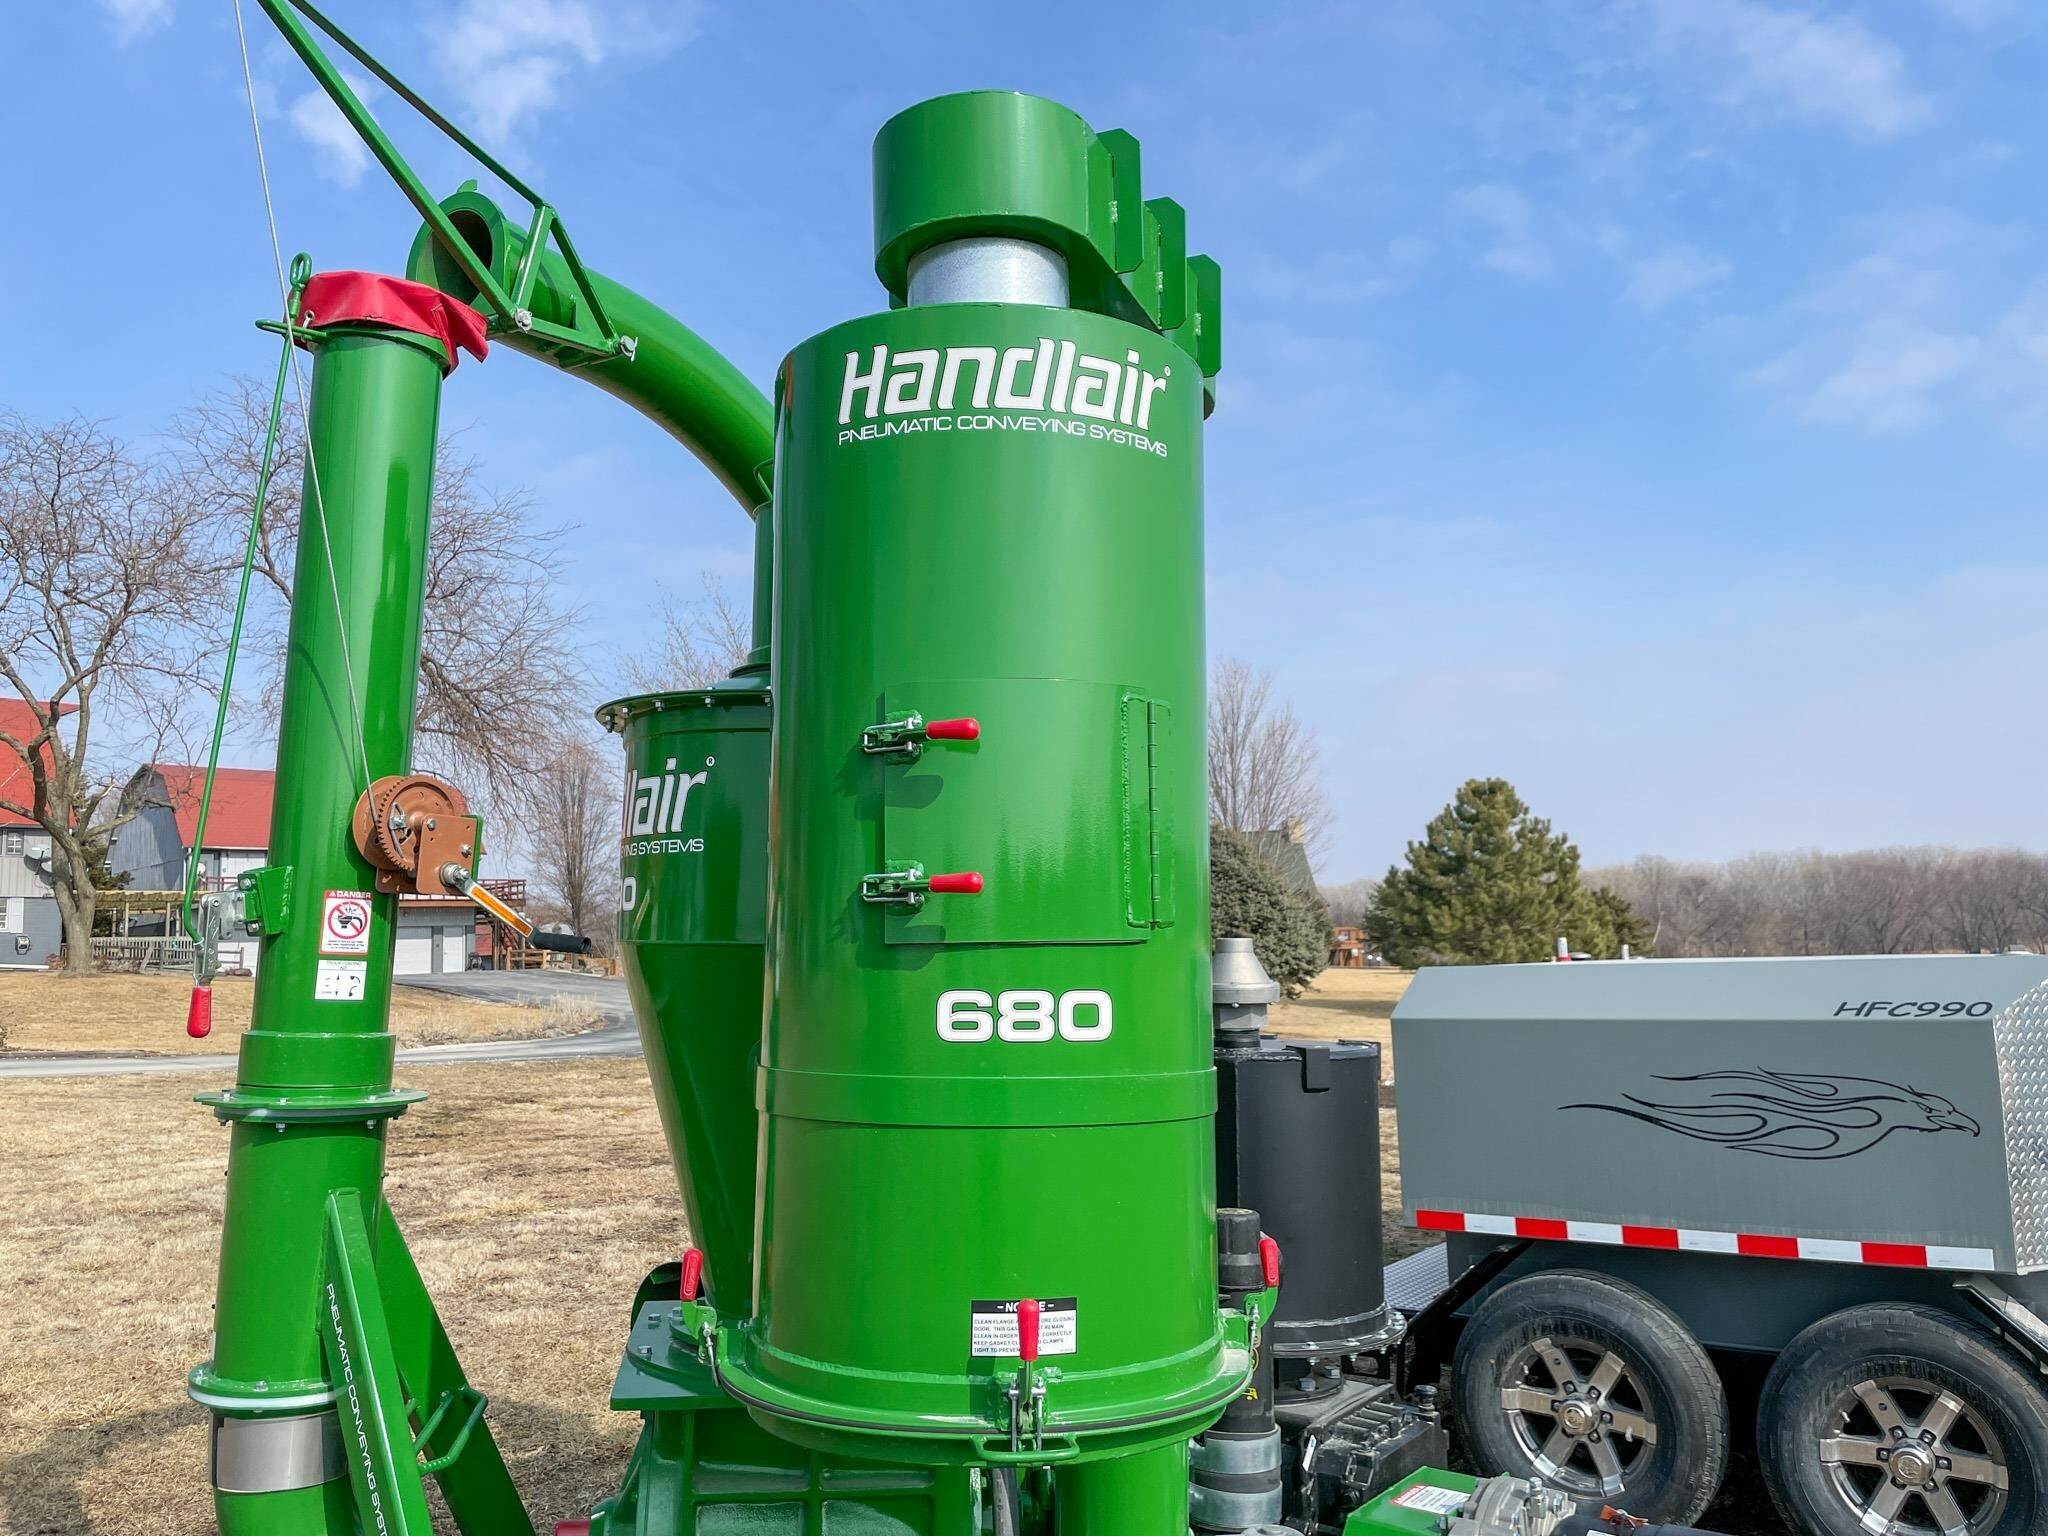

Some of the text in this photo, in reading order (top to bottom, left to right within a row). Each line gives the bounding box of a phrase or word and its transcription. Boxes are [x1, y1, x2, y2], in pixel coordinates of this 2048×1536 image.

[838, 415, 1168, 458] PNEUMATIC CONVEYING SYSTEMS
[638, 838, 705, 855] SYSTEMS
[337, 891, 371, 899] DANGER
[936, 988, 1113, 1043] 680
[1833, 1001, 1993, 1018] HFC990
[326, 1282, 388, 1536] PNEUMATIC CONVEYING SYST
